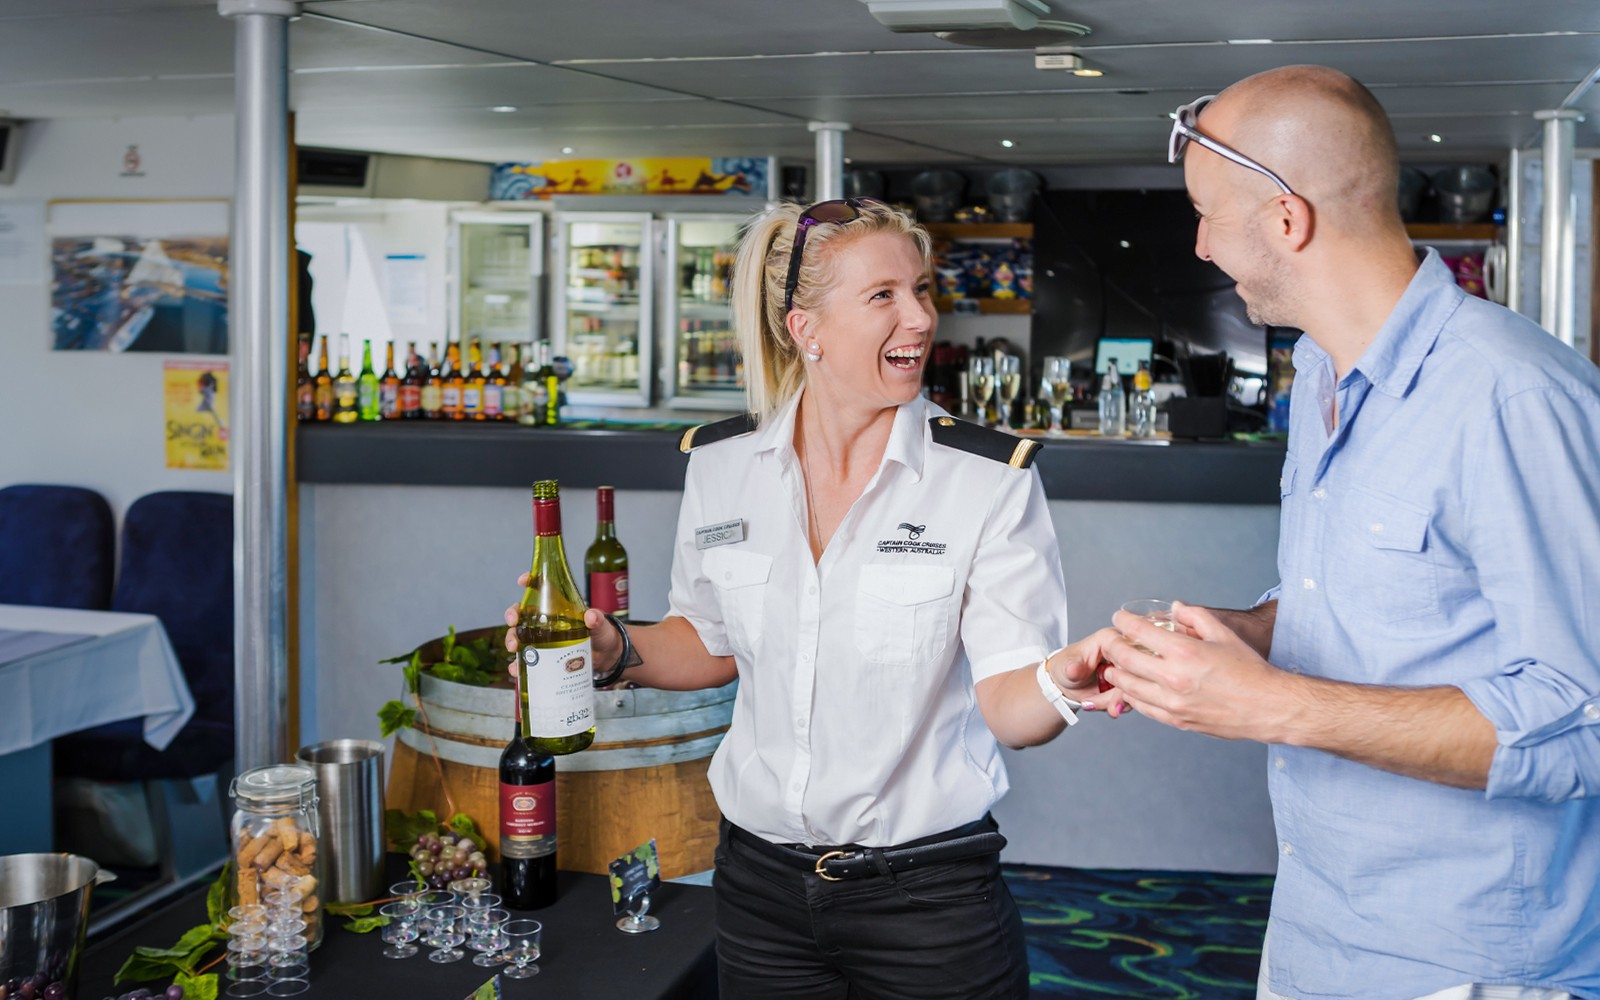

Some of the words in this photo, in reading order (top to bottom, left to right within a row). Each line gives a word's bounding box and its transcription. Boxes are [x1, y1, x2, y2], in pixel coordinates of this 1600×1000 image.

[921, 541, 947, 549] CRUISES
[879, 546, 908, 554] WESTERN
[909, 547, 943, 555] AUSTRALIA
